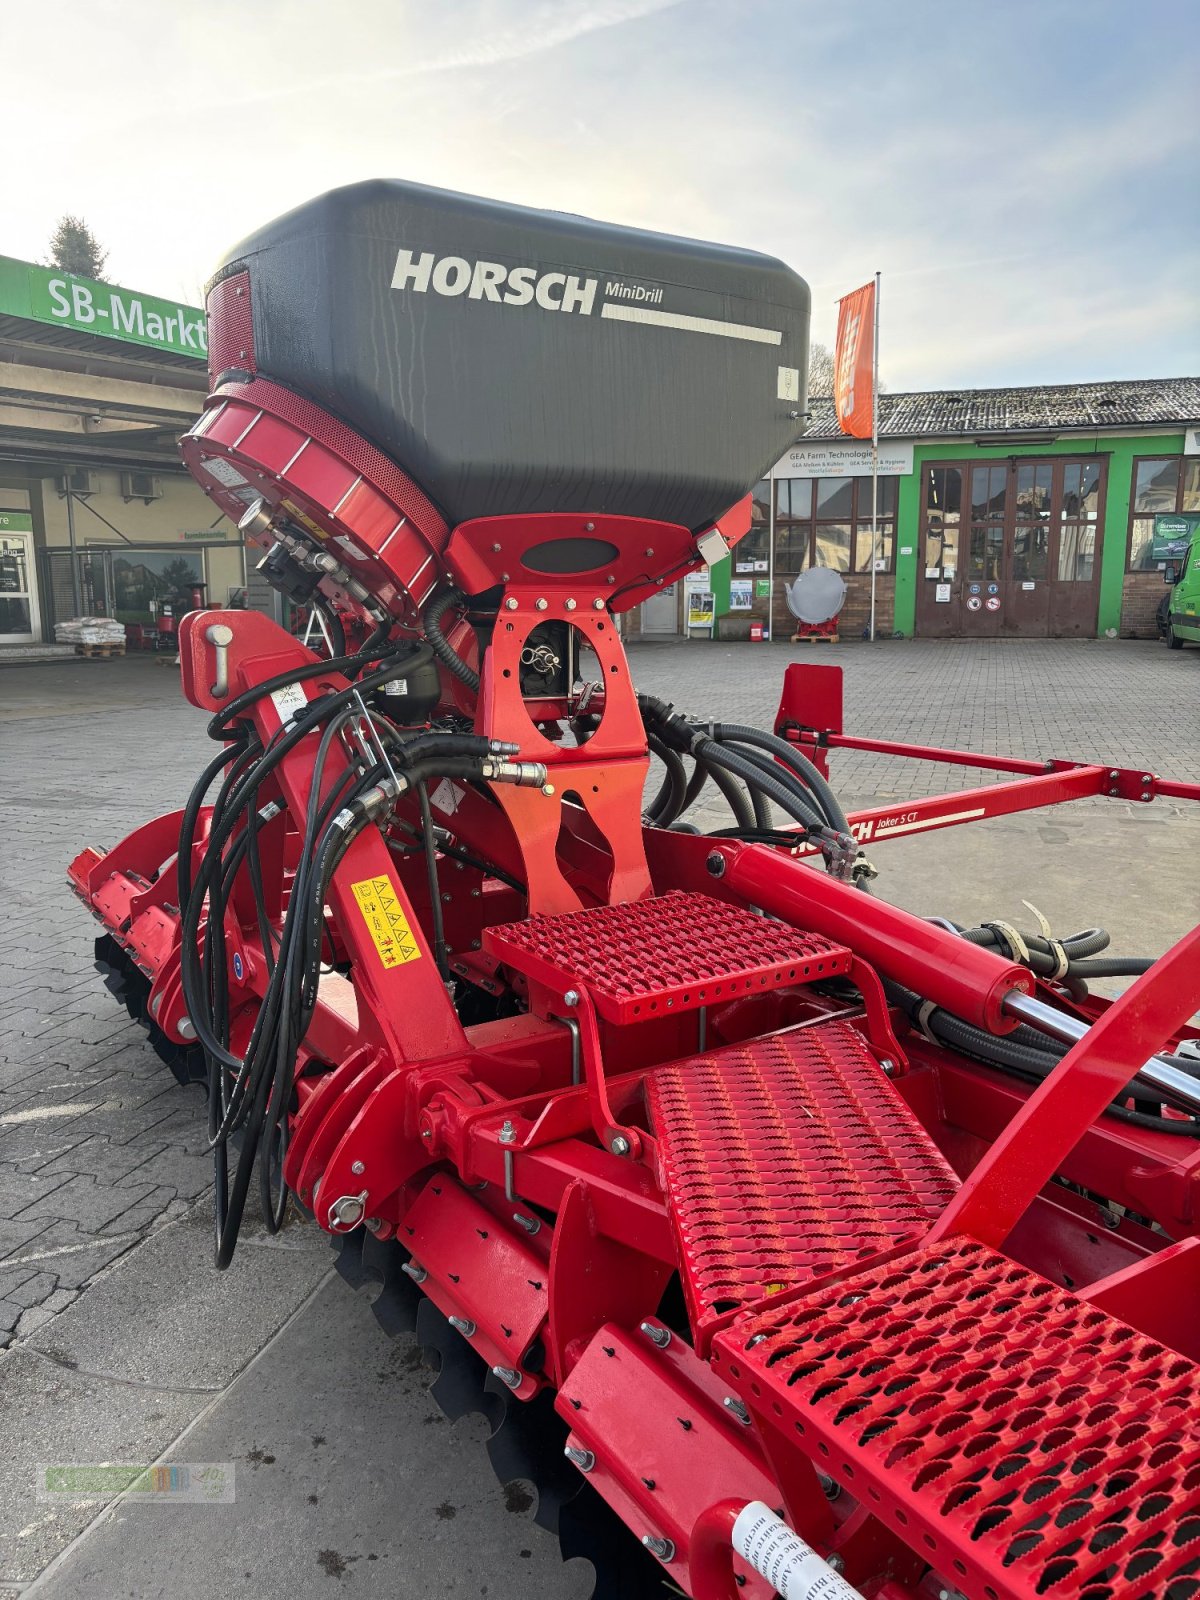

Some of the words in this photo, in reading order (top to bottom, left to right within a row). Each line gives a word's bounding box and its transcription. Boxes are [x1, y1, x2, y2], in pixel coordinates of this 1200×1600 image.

[391, 249, 598, 315] HORSCH
[605, 281, 663, 303] MiniDrill
[48, 278, 207, 350] SB-Markt
[789, 452, 805, 460] GEA
[877, 817, 899, 829] Joker
[900, 815, 905, 824] 5
[907, 812, 918, 823] CT
[784, 1541, 799, 1553] the
